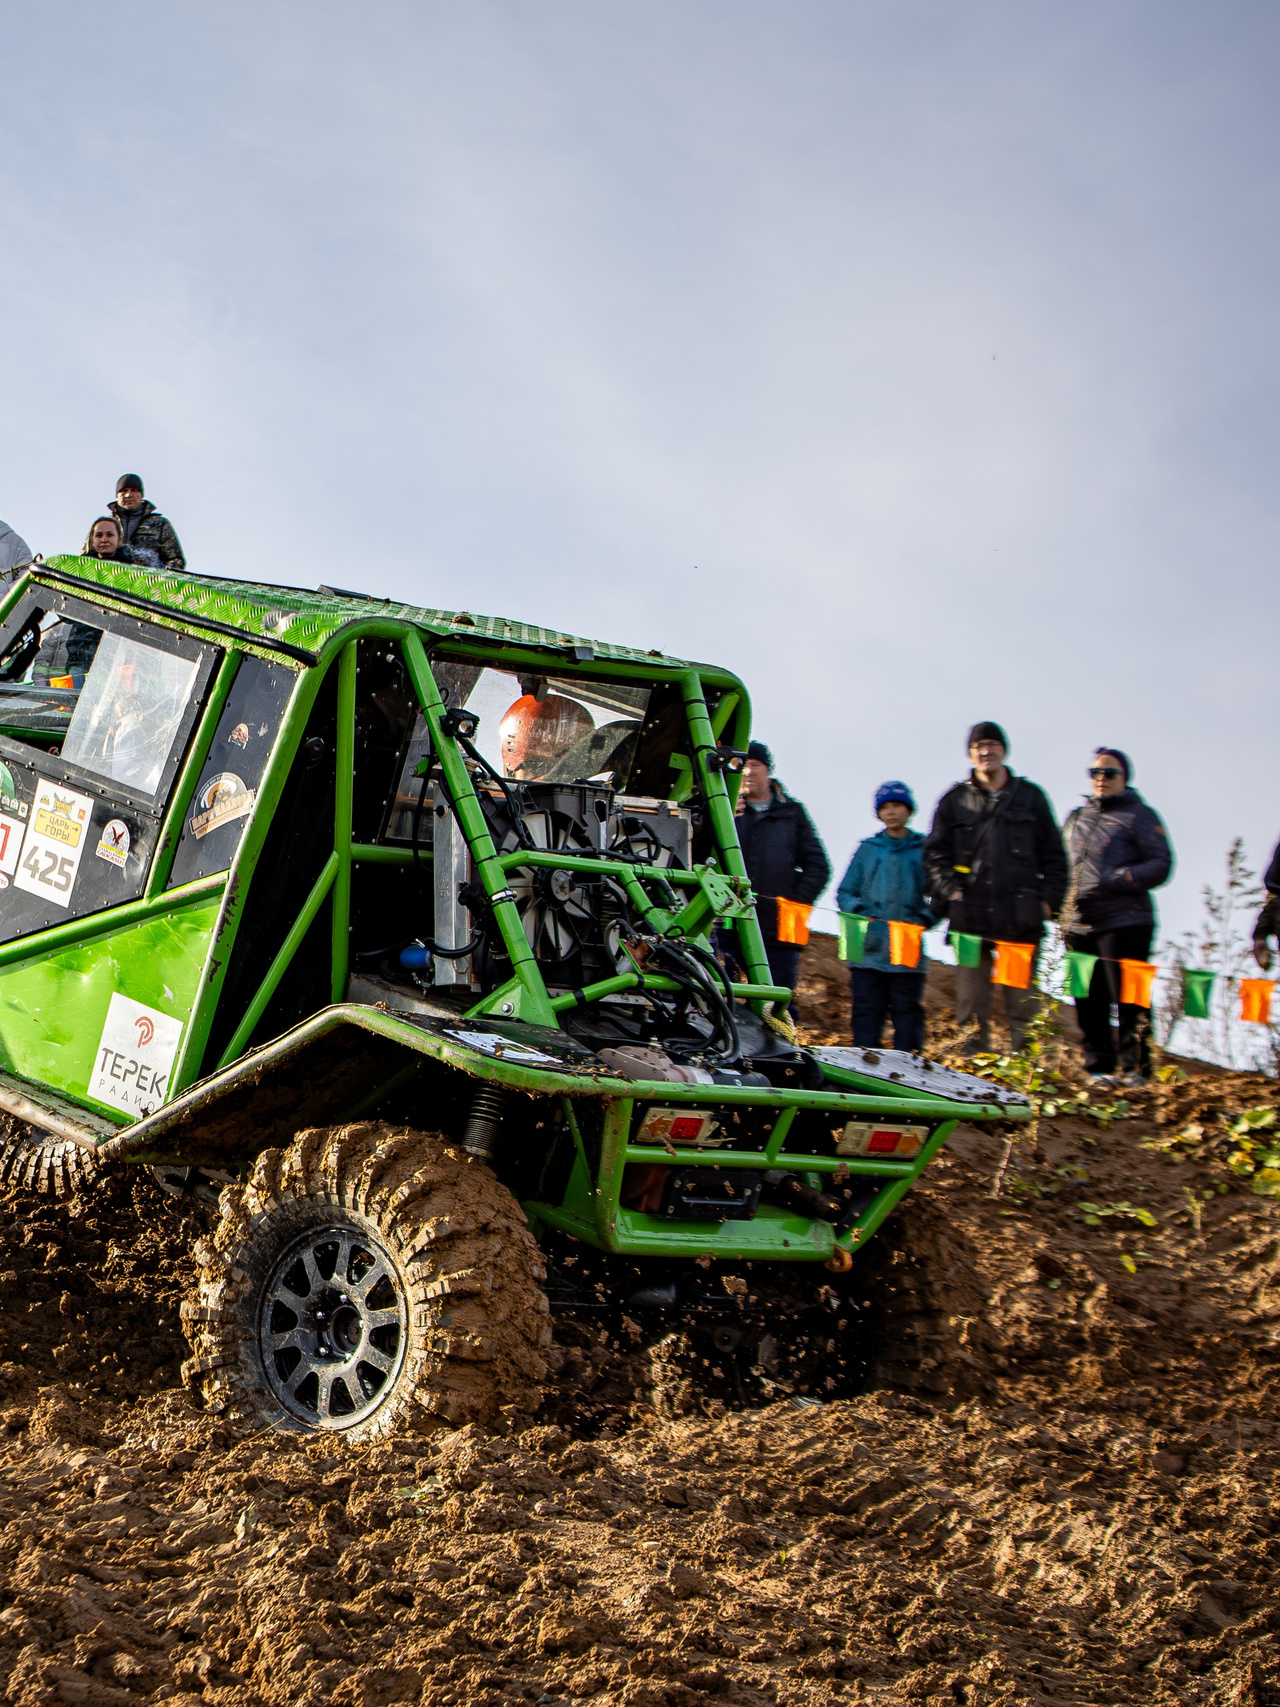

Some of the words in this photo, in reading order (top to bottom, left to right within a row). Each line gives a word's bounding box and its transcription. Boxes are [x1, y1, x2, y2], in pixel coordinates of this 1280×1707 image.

[45, 824, 70, 841] ГОРЫ
[49, 816, 69, 830] ЦАРЬ
[22, 845, 75, 893] 425
[101, 1047, 167, 1098] ТЕРЕК
